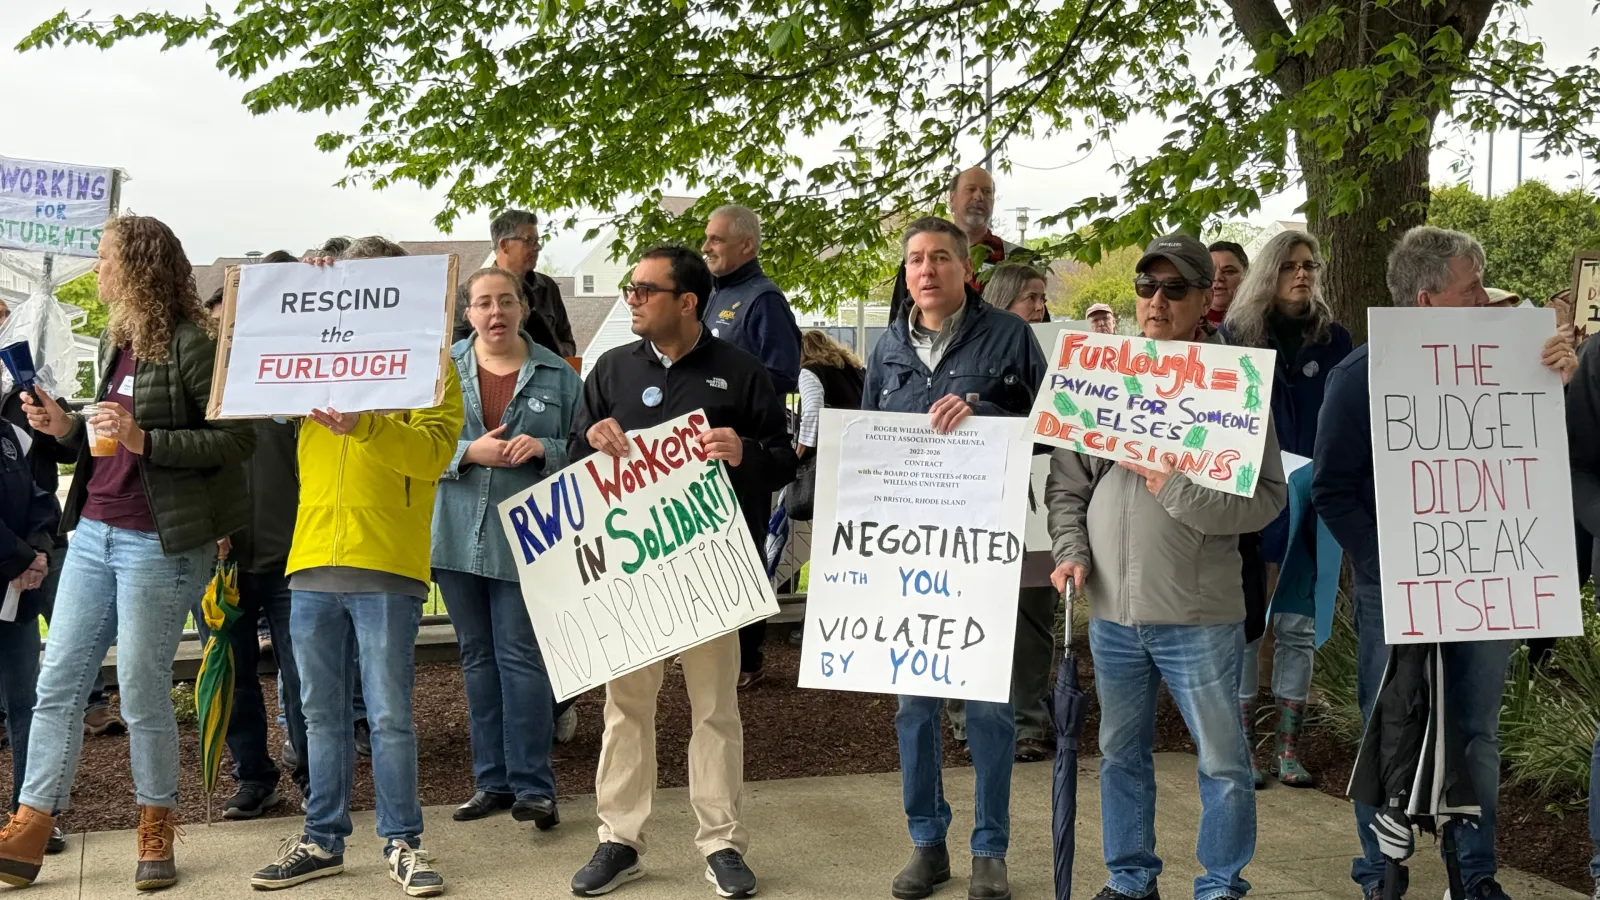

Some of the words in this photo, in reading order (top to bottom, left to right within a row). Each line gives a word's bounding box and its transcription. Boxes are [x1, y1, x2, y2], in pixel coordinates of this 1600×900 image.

[0, 163, 105, 200] WORKING
[36, 202, 67, 220] FOR
[280, 287, 400, 314] RESCIND
[321, 327, 355, 343] the
[258, 354, 407, 380] FURLOUGH
[1421, 343, 1500, 386] THE
[1050, 373, 1119, 401] PAYING
[1126, 394, 1168, 416] FOR
[873, 425, 898, 433] ROGER
[899, 426, 935, 435] WILLIAMS
[1096, 407, 1183, 441] ELSE'S
[1384, 391, 1546, 452] BUDGET
[865, 433, 897, 442] FACULTY
[898, 435, 946, 445] ASSOCIATION
[909, 448, 941, 456] 2022-2026
[1033, 411, 1241, 481] DECISIONS
[883, 470, 909, 478] BOARD
[920, 472, 954, 480] TRUSTEES
[962, 473, 987, 481] ROGER
[904, 459, 943, 468] CONTRACT
[883, 478, 918, 487] WILLIAMS
[919, 480, 960, 489] UNIVERSITY
[1411, 457, 1538, 515] DIDN'T
[914, 497, 940, 505] RHODE
[940, 498, 967, 506] ISLAND
[508, 472, 585, 565] RWU
[832, 519, 1020, 565] NEGOTIATED
[1413, 516, 1544, 577] BREAK
[824, 570, 868, 585] WITH
[1397, 574, 1559, 636] ITSELF
[818, 613, 985, 651] VIOLATED
[546, 610, 592, 695] NO
[820, 650, 855, 678] BY
